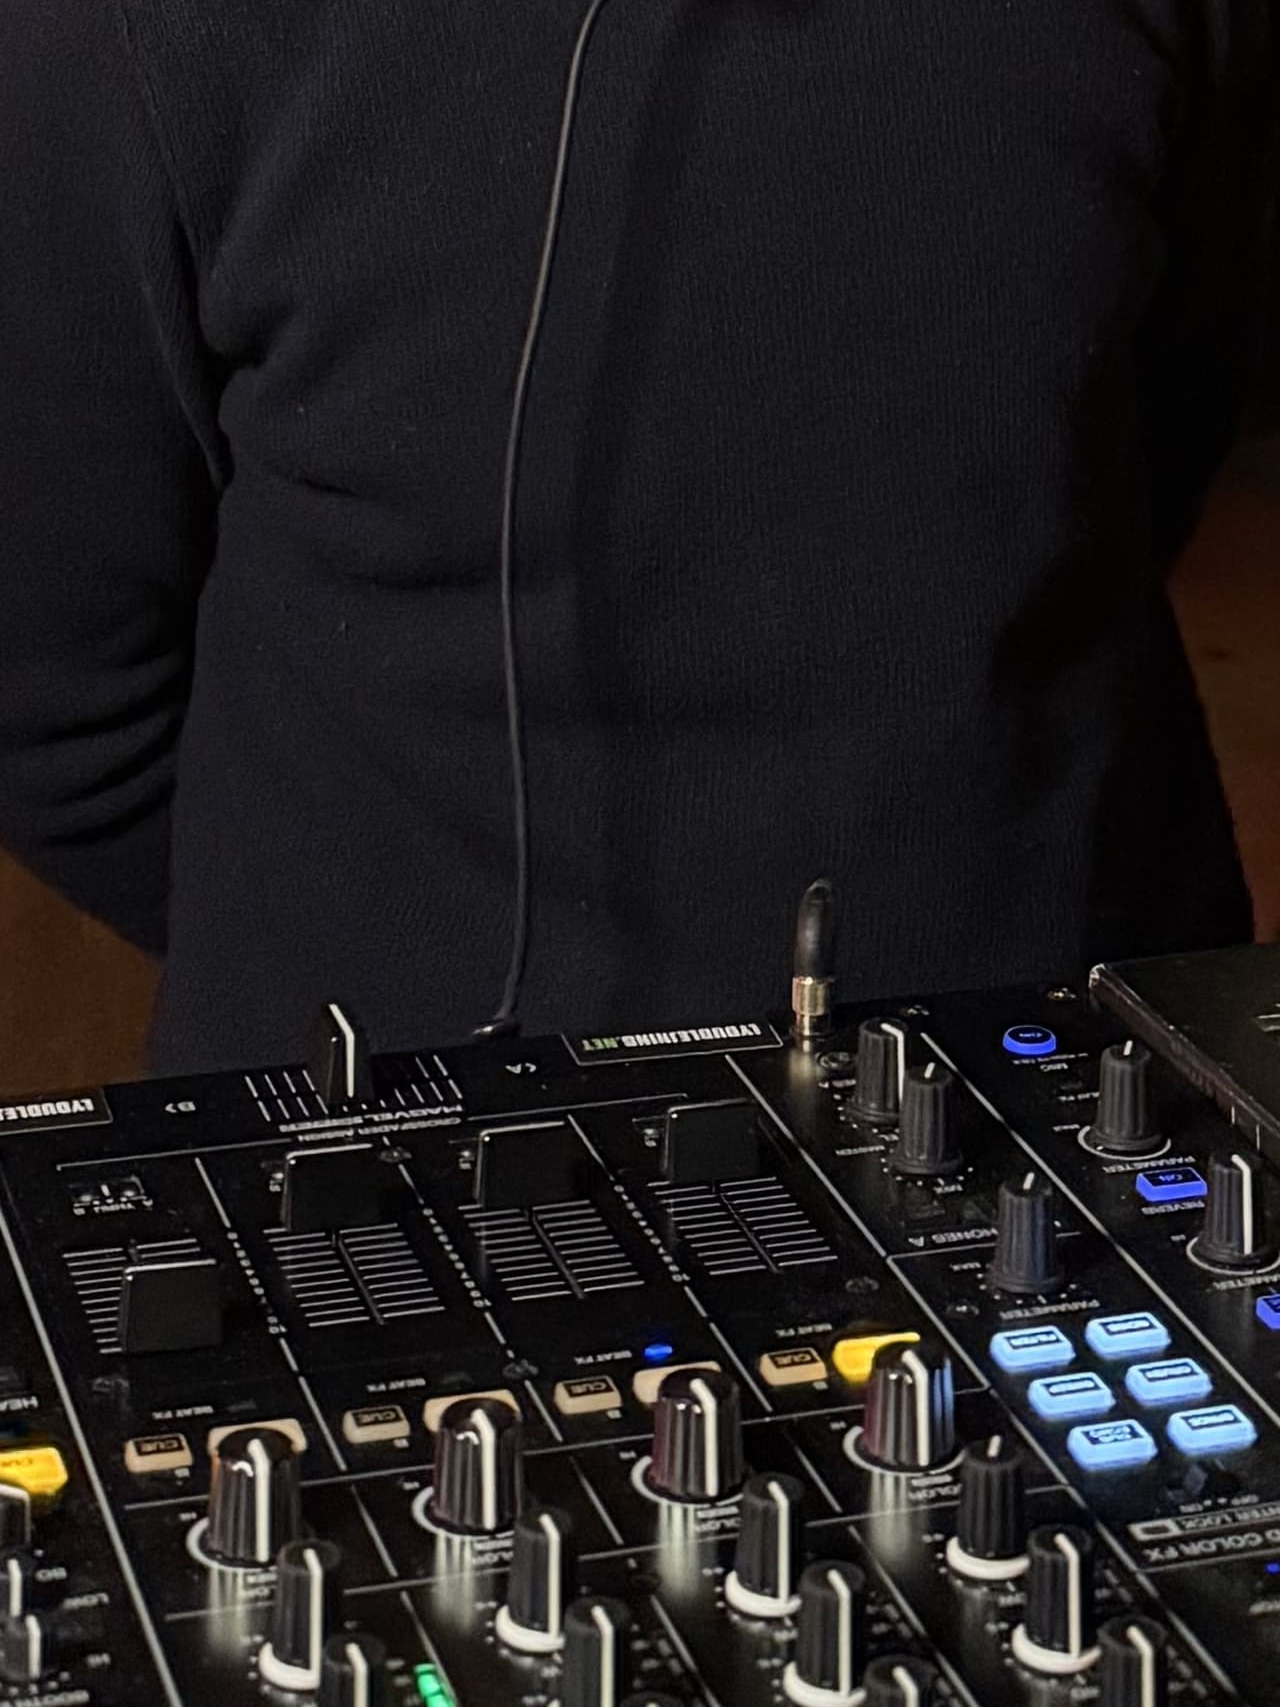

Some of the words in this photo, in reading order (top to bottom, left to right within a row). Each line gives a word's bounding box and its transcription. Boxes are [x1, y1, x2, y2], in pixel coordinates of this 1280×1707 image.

[581, 1023, 761, 1051] LYDUDLEJNING.NET
[773, 1352, 813, 1366] CUE
[569, 1380, 608, 1394] CUE
[357, 1409, 398, 1424] CUE
[138, 1439, 178, 1452] CUE
[1178, 1531, 1264, 1557] COLOR
[1142, 1545, 1178, 1563] FX
